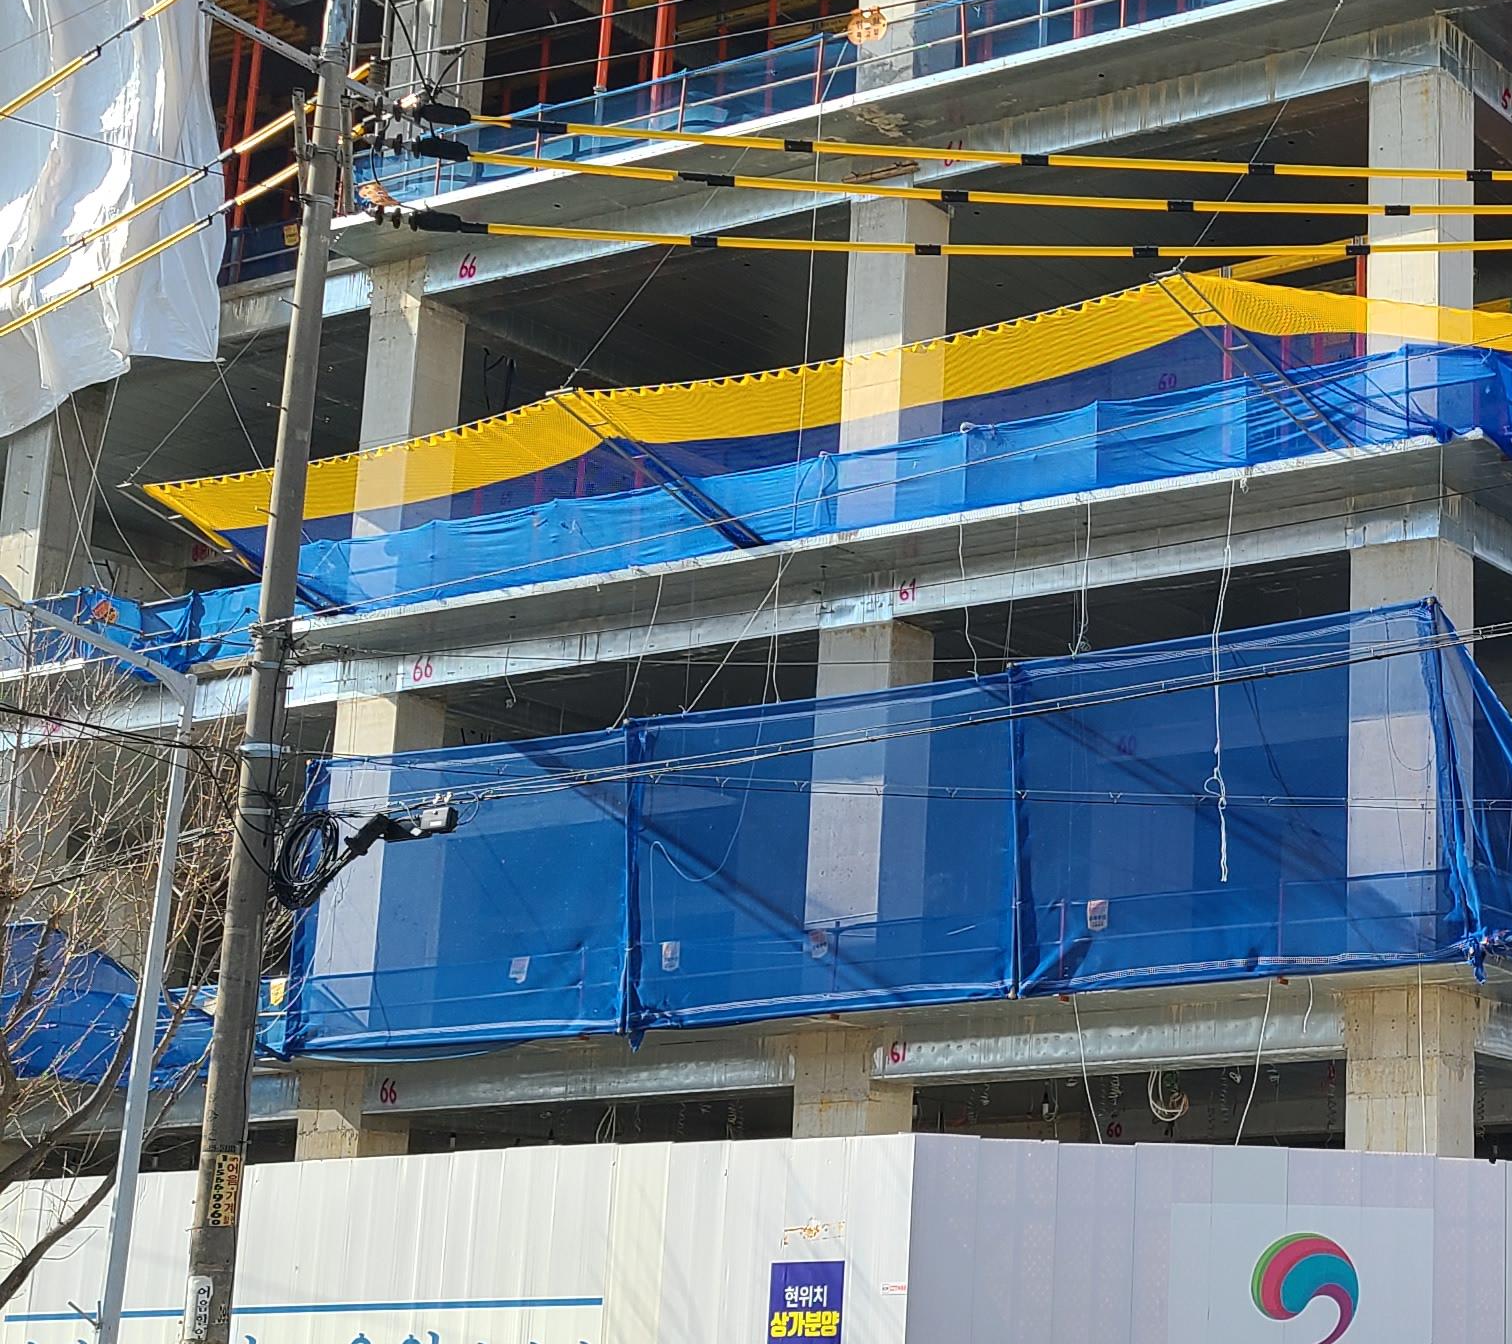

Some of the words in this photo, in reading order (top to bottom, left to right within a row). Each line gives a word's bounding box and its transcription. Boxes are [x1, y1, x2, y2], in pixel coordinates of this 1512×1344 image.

[459, 252, 477, 278] 66
[900, 578, 916, 601] 61
[413, 655, 433, 682] 66
[890, 1040, 907, 1064] 61
[380, 1077, 397, 1104] 66
[1106, 1122, 1122, 1138] 60
[784, 1285, 828, 1308] 현위치
[770, 1311, 840, 1338] 상가분양
